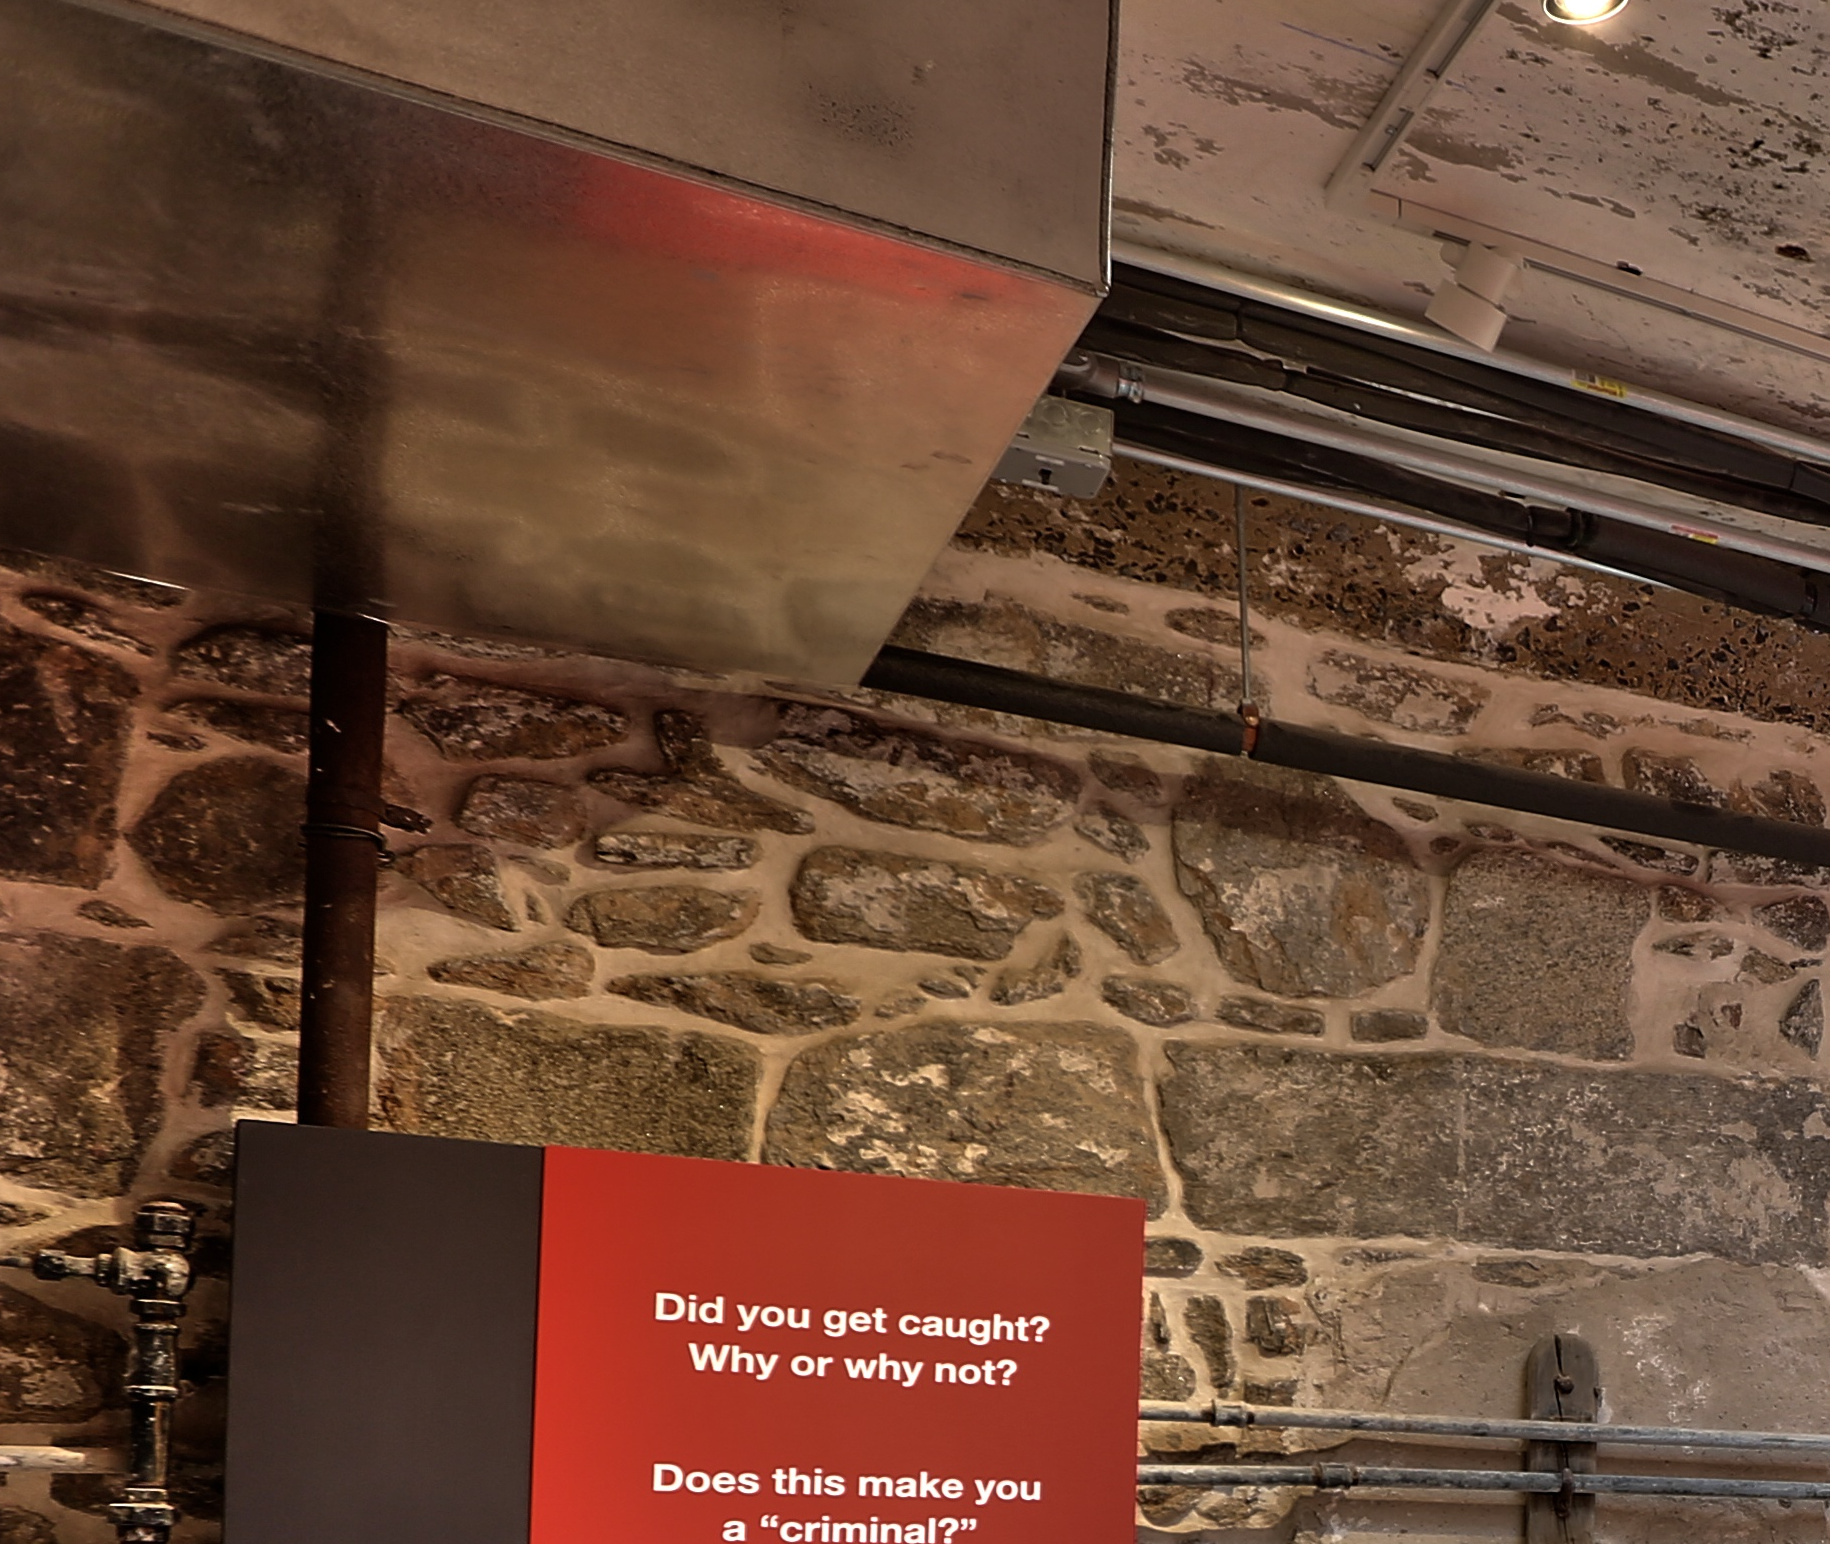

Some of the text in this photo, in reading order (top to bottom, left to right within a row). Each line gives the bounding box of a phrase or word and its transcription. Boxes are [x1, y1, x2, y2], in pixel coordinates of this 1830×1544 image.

[654, 1291, 1051, 1346] Did you get caught?
[688, 1342, 1018, 1387] Why or why not?
[652, 1463, 1042, 1506] Does this make you
[722, 1514, 977, 1544] a “criminal?”
